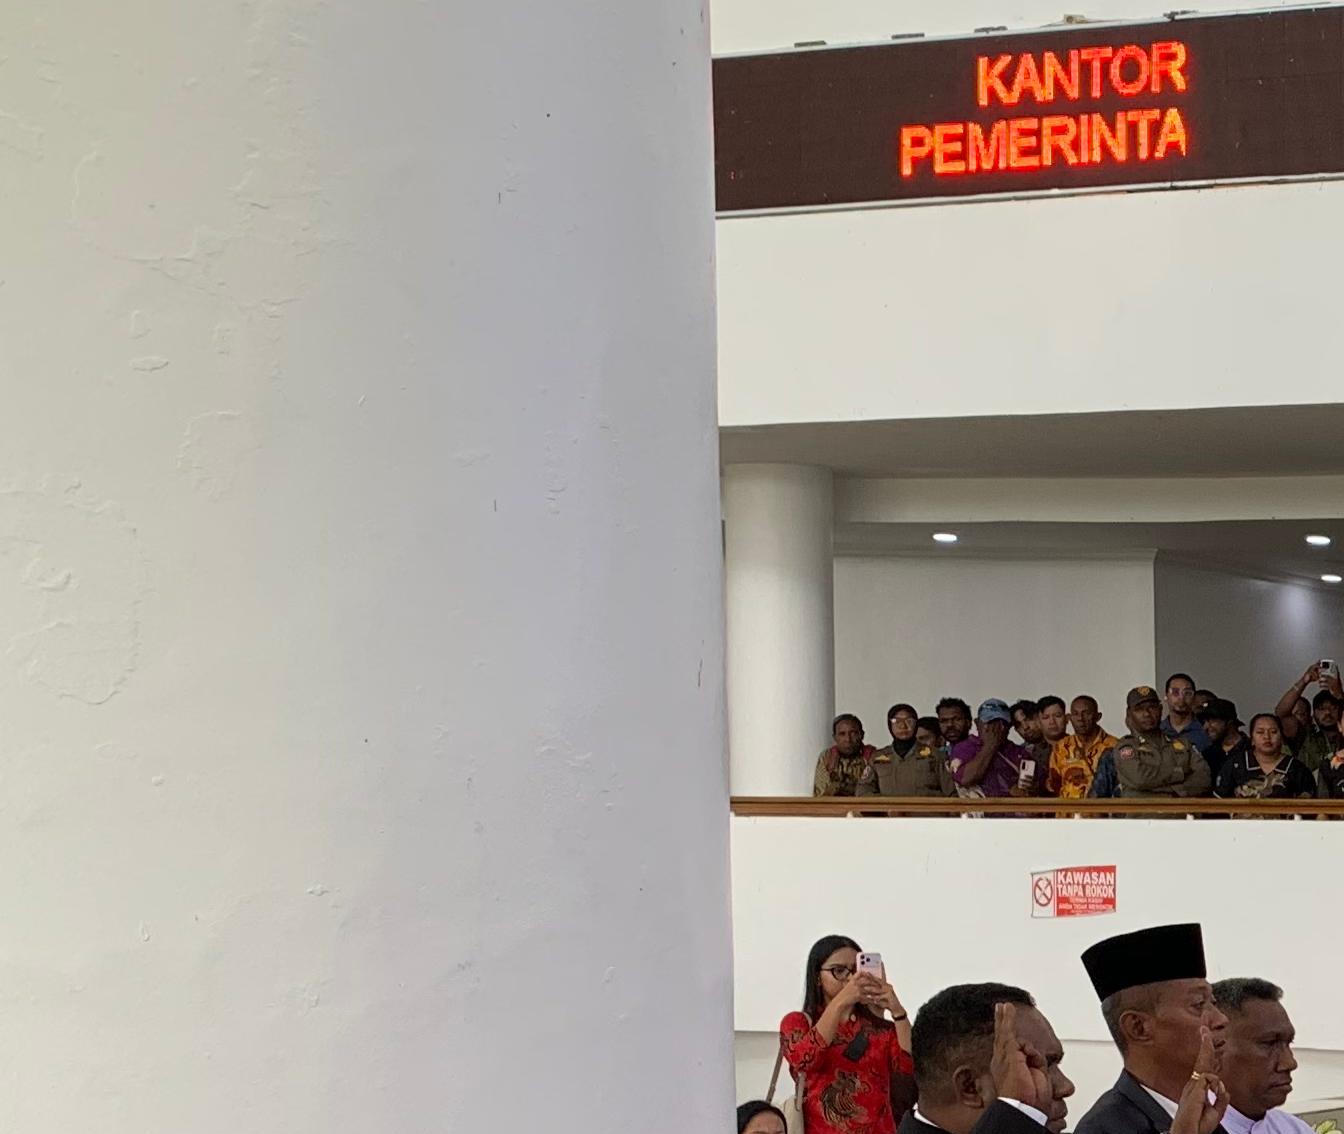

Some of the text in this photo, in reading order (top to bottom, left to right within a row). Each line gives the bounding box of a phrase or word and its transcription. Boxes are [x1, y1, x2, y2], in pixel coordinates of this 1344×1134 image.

[977, 40, 1188, 108] KANTOR
[899, 107, 1188, 177] PEMERINTA
[1057, 871, 1115, 886] KAWASAN
[1057, 885, 1115, 898] TANPA ROKOK
